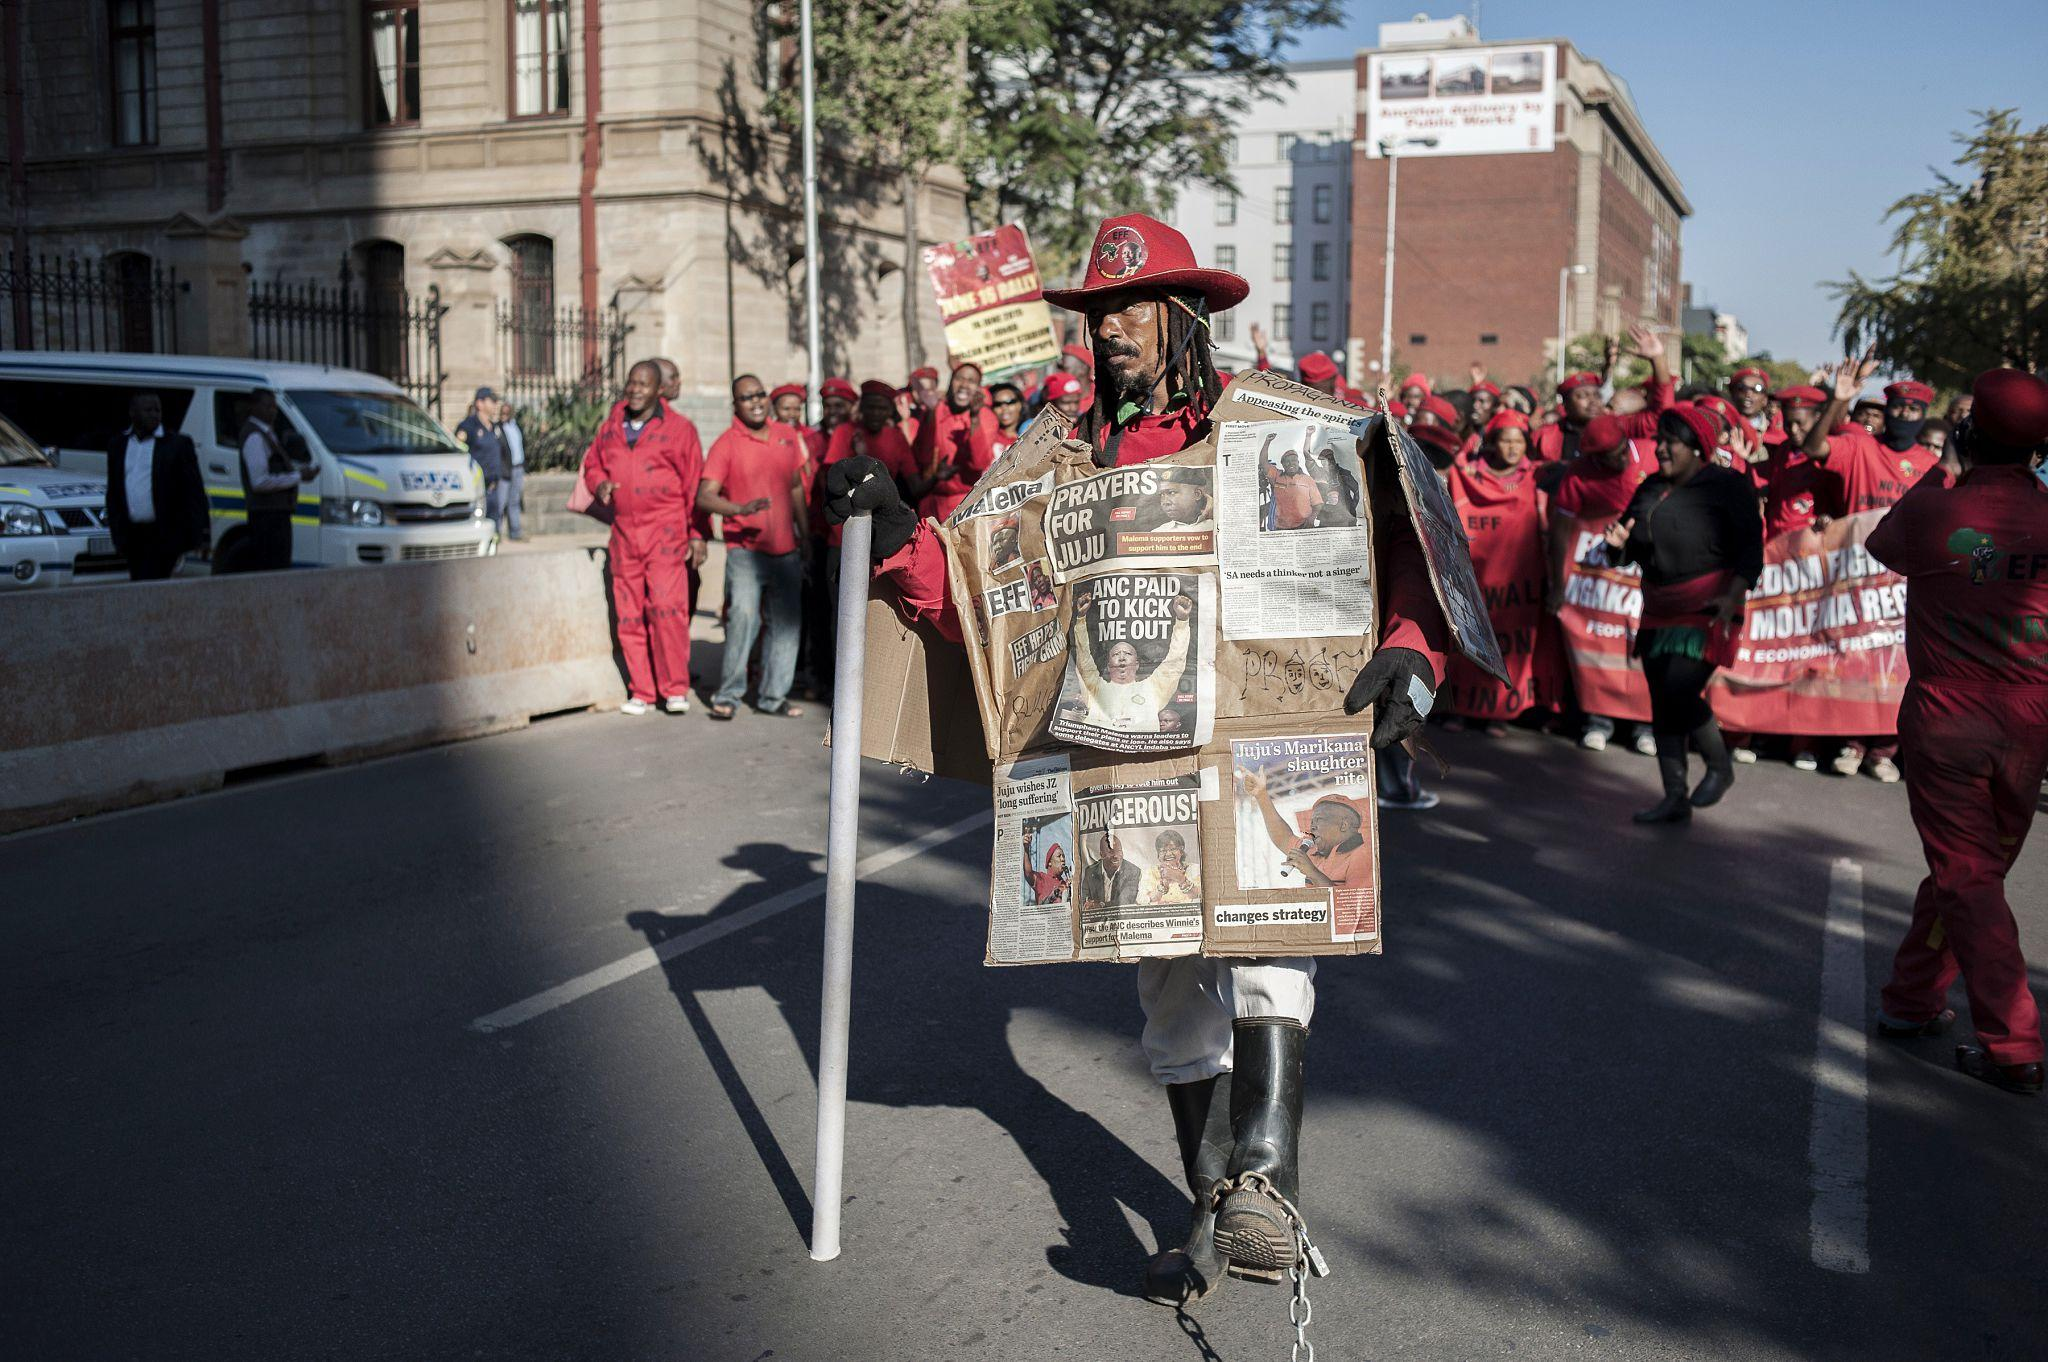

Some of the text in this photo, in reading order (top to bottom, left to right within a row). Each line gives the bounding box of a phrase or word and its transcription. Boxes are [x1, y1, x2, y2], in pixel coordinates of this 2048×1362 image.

[1112, 230, 1129, 241] EFF
[1236, 392, 1362, 429] Appeasing the spirits
[1053, 470, 1158, 511] PRAYERS
[1051, 508, 1093, 539] FOR
[1467, 515, 1502, 531] EFF
[1121, 534, 1149, 543] Malema
[1149, 534, 1186, 544] supporters
[1128, 544, 1154, 553] support
[1155, 543, 1169, 551] him
[1177, 543, 1189, 551] the
[1189, 542, 1203, 551] end
[1057, 532, 1106, 570] JUJU
[1240, 569, 1266, 579] needs
[1308, 570, 1324, 579] not
[986, 580, 1027, 616] EFF
[1092, 576, 1181, 600] ANC PAID
[1098, 597, 1173, 620] TO KICK
[1098, 619, 1172, 642] ME OUT
[1013, 636, 1029, 660] EFF
[1053, 725, 1083, 737] support
[1083, 729, 1101, 739] their
[1100, 733, 1121, 744] plans
[1174, 738, 1192, 746] says
[1054, 731, 1075, 740] some
[1074, 734, 1110, 748] delegates
[1058, 719, 1101, 734] Triumphant
[1101, 728, 1130, 739] Malema
[1153, 732, 1181, 740] leaders
[1284, 738, 1364, 756] Marikana
[1287, 755, 1365, 774] slaughter
[996, 777, 1058, 798] Juju wishes JZ
[1151, 779, 1166, 787] him
[1166, 777, 1179, 786] out
[1334, 771, 1366, 786] rite
[1079, 792, 1198, 832] DANGEROUS!
[1109, 922, 1125, 931] ANC
[1126, 919, 1165, 930] describes
[1216, 910, 1269, 924] changes
[1272, 907, 1327, 923] strategy
[1084, 933, 1108, 945] support
[1119, 931, 1153, 941] Malema
